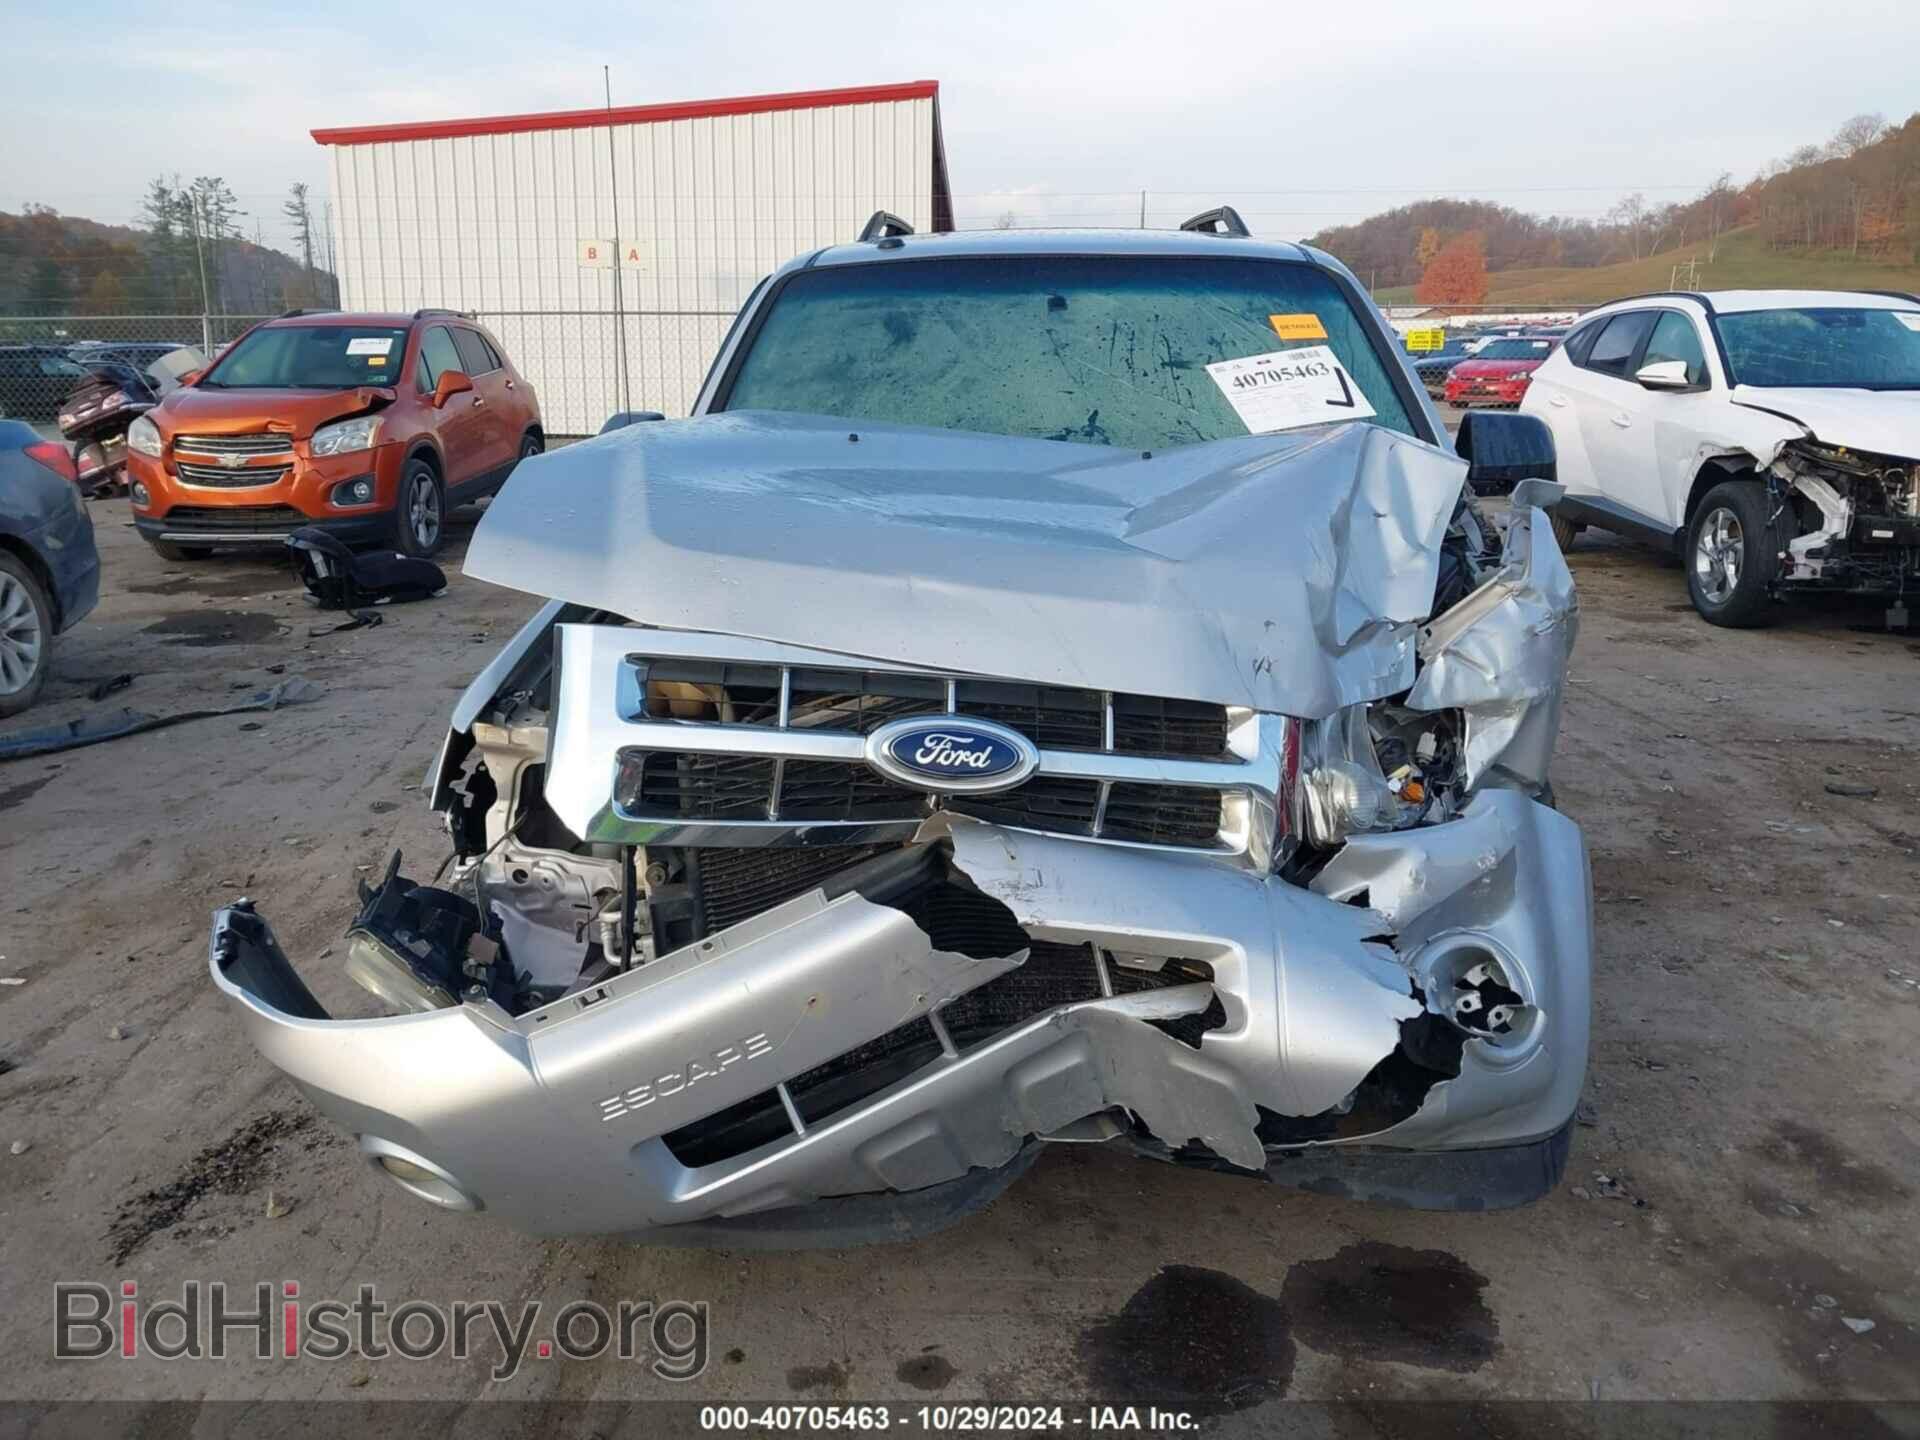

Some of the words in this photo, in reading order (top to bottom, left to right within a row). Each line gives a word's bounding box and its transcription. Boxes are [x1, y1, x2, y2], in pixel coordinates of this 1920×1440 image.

[587, 247, 598, 260] B
[628, 248, 639, 261] A
[1232, 361, 1331, 389] 40705463
[914, 733, 993, 768] Ford
[598, 1032, 773, 1122] ESCAPE
